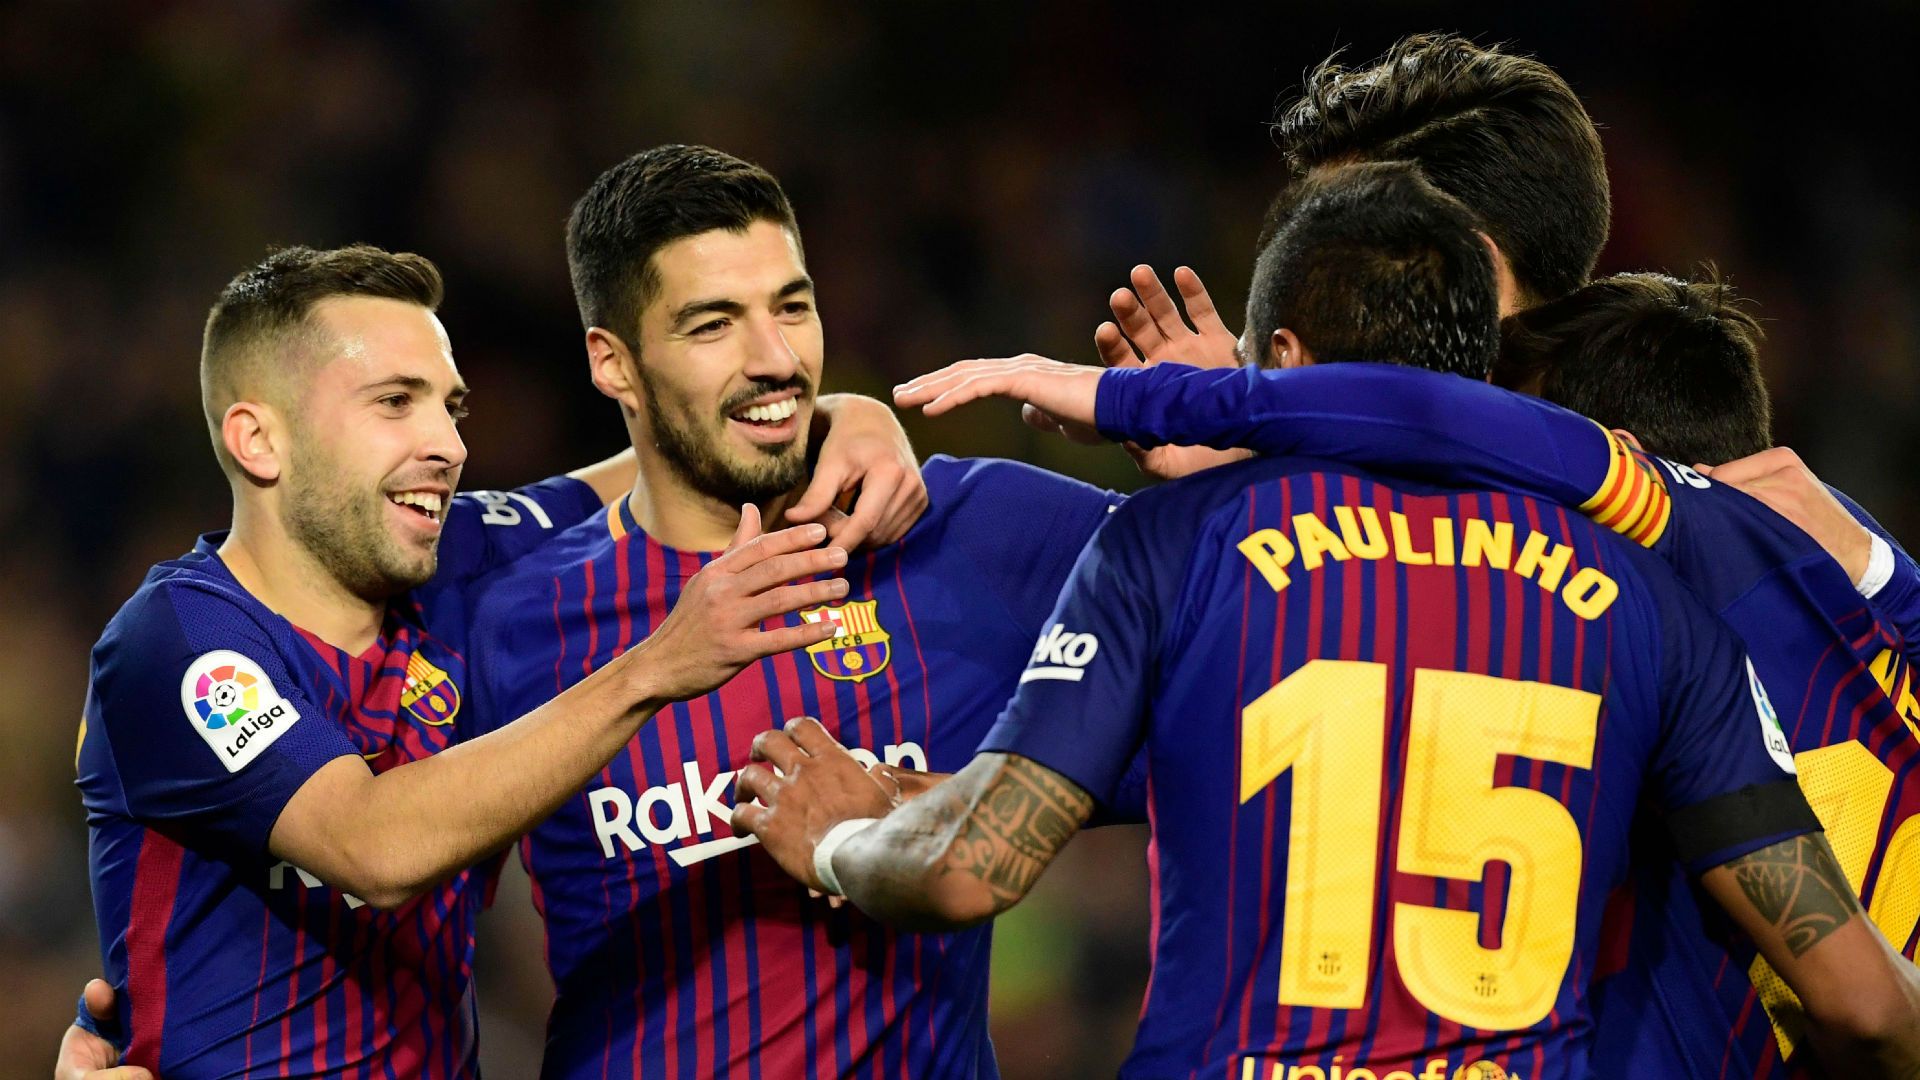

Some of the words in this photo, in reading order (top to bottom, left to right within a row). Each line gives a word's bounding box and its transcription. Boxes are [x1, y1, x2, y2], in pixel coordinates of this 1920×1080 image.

[1237, 505, 1619, 620] PAULINHO
[831, 634, 862, 648] FCB
[226, 705, 285, 757] LaLiga
[1767, 734, 1790, 754] LaL
[1239, 658, 1602, 1032] 15
